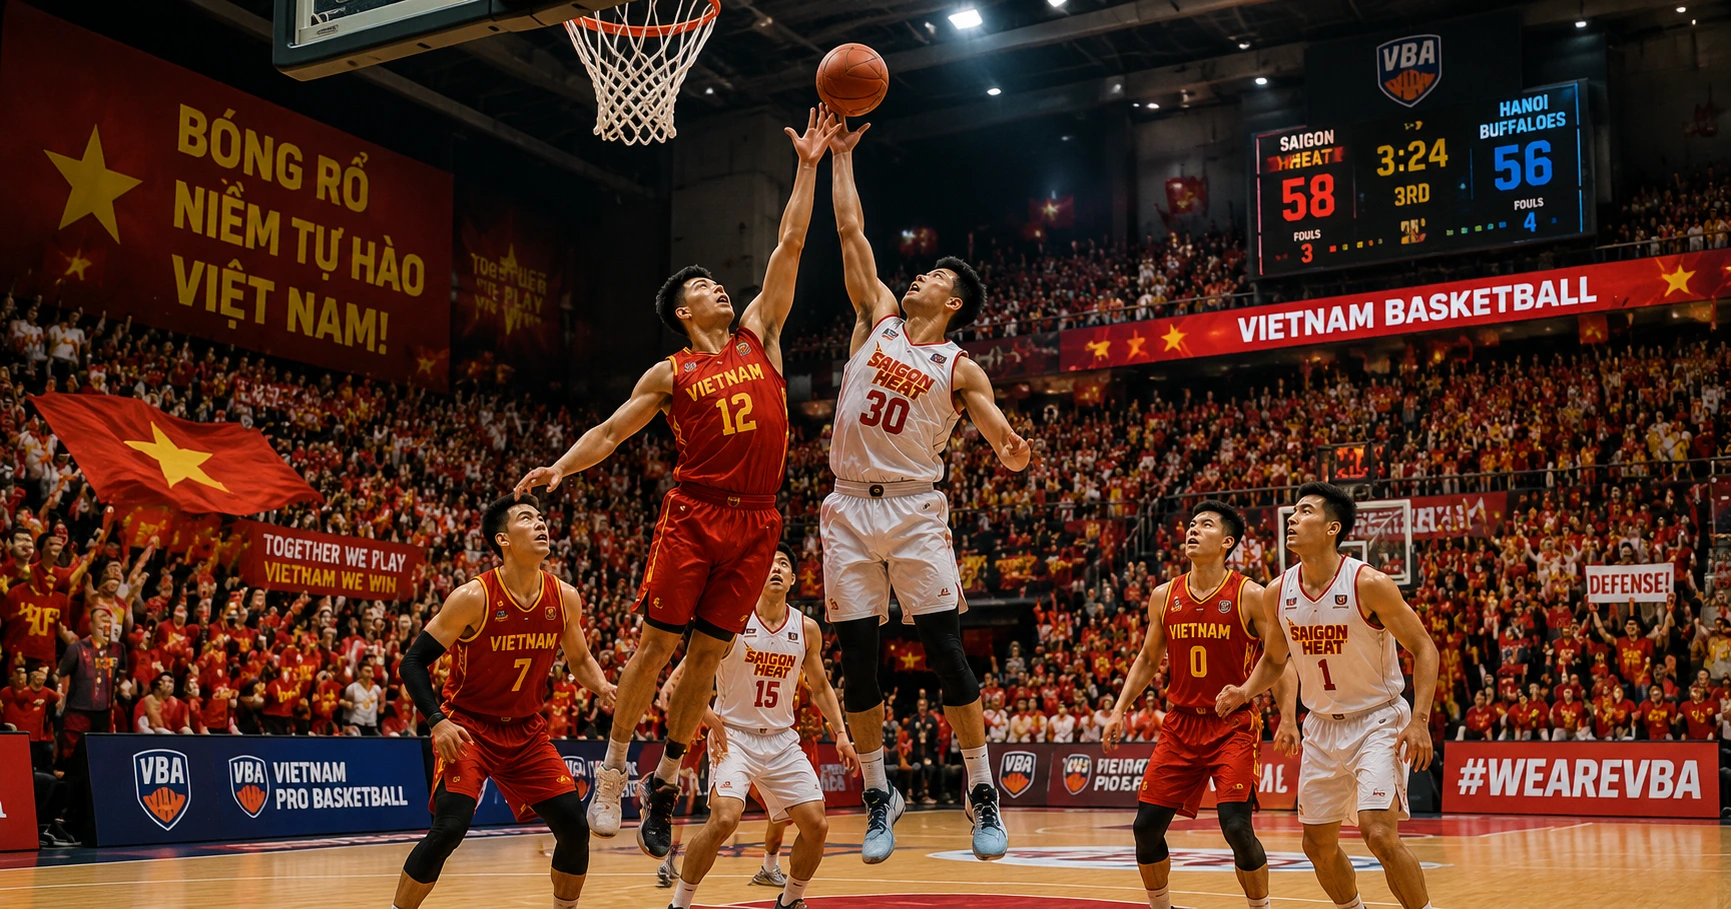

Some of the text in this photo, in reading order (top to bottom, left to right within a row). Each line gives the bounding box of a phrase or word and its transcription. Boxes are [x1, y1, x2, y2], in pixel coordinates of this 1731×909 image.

[1383, 40, 1435, 72] VBA
[1499, 94, 1548, 117] HANOI
[1479, 111, 1566, 139] BUFFALOES
[1280, 129, 1334, 151] SAIGON
[177, 103, 369, 213] BÓNG RỔ
[1376, 138, 1448, 176] 3:24
[1494, 140, 1552, 191] 56
[1282, 173, 1335, 222] 58
[1394, 182, 1430, 206] 3RD
[1513, 197, 1544, 211] FOULS
[1293, 229, 1321, 242] FOULS
[1523, 211, 1537, 233] 4
[173, 178, 425, 297] NIỀM TỰ HÀO
[1300, 243, 1313, 264] 3
[171, 253, 389, 355] VIỆT NAM!
[1237, 276, 1597, 343] VIETNAM BASKETBALL
[685, 362, 765, 402] VIETNAM
[866, 351, 935, 391] SAIGON
[871, 369, 928, 401] HEAT
[715, 392, 757, 436] 12
[859, 389, 911, 435] 30
[263, 533, 406, 573] TOGETHER WE PLAY
[341, 570, 365, 591] WE
[369, 573, 397, 594] WIN
[1589, 571, 1670, 595] DEFENSE!
[490, 633, 558, 652] VIETNAM
[1169, 622, 1231, 640] VIETNAM
[1290, 624, 1348, 641] SAIGON
[744, 650, 797, 668] SAIGON
[1190, 645, 1207, 678] 0
[1301, 640, 1345, 655] HEAT
[511, 657, 532, 692] 7
[753, 664, 791, 679] HEAT
[1317, 658, 1337, 691] 1
[753, 680, 780, 708] 15
[139, 756, 185, 785] VBA
[233, 761, 265, 784] VBA
[272, 761, 347, 783] VIETNAM
[1005, 755, 1033, 773] VBA
[1457, 758, 1702, 799] #WEAREVBA
[276, 785, 408, 810] PRO BASKETBALL
